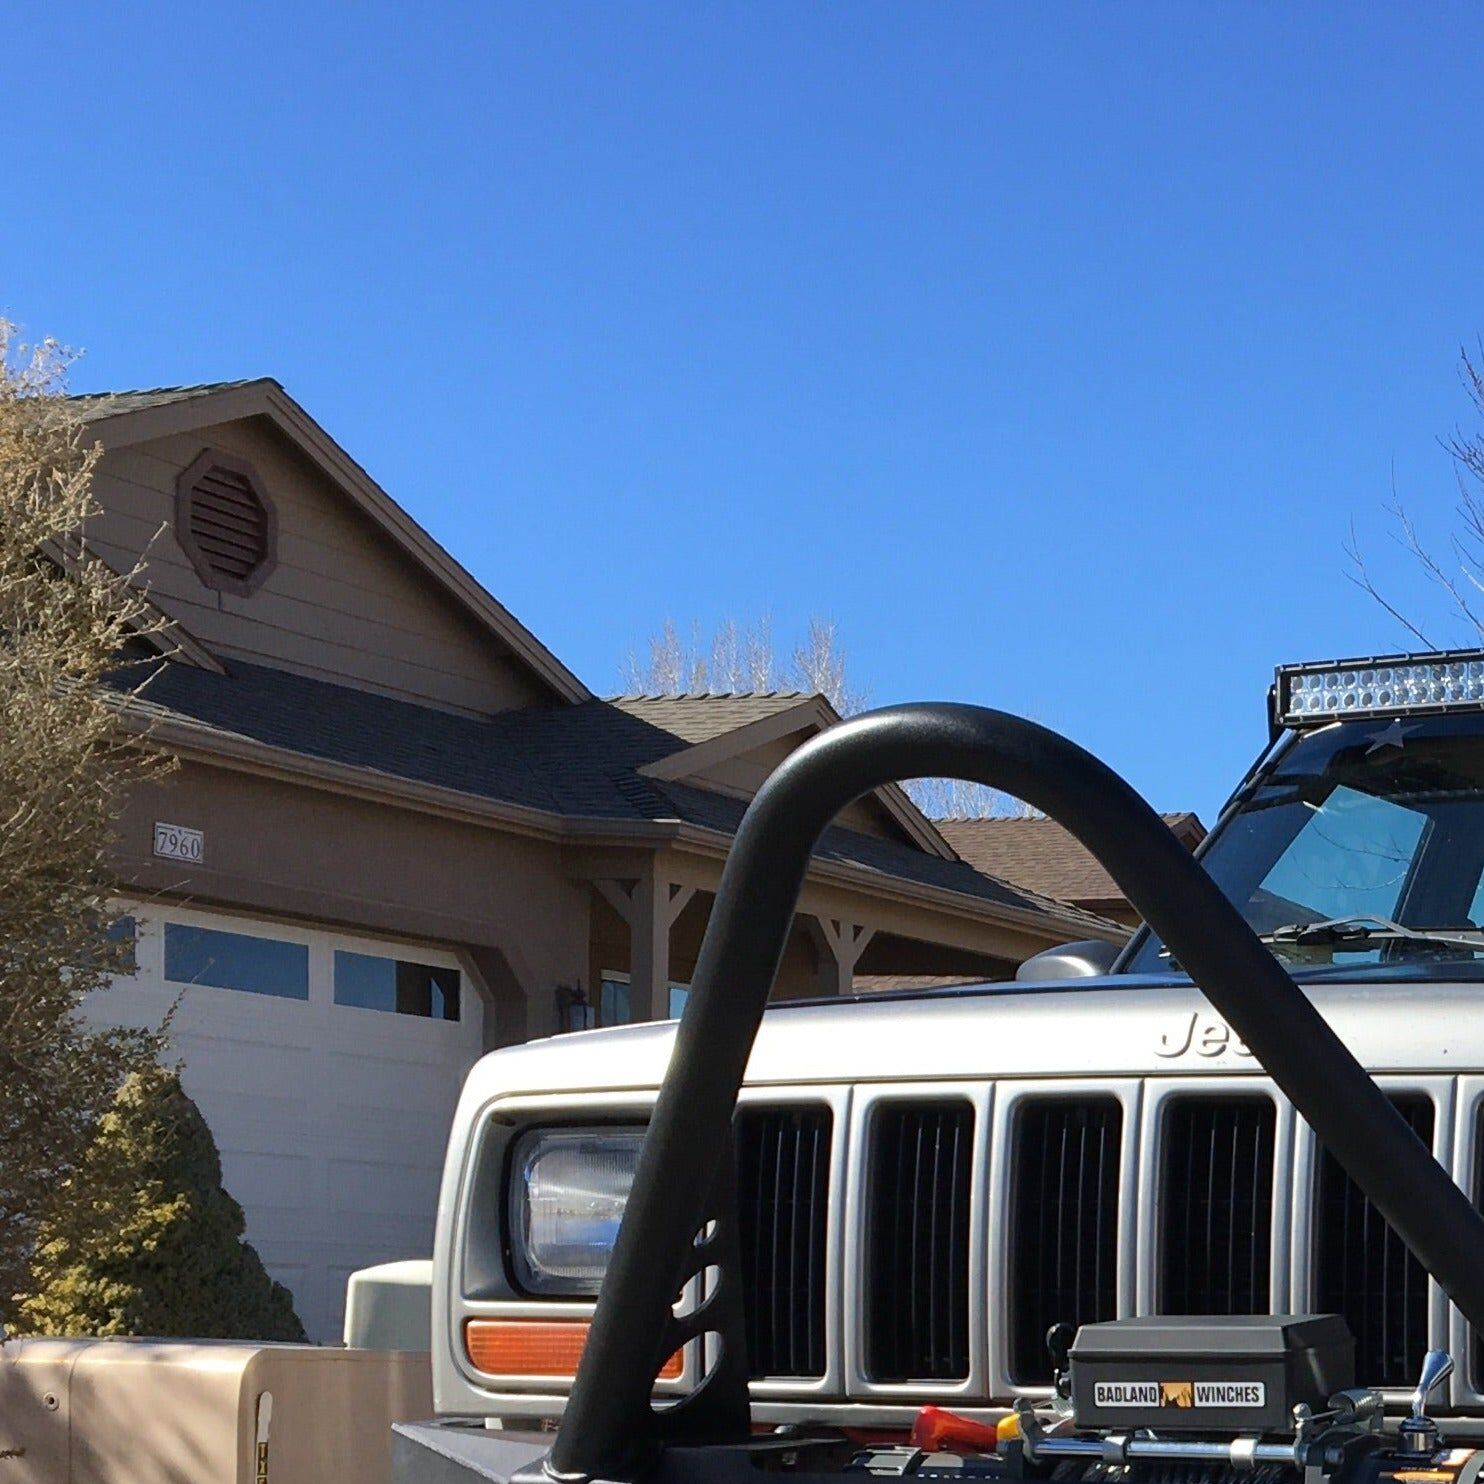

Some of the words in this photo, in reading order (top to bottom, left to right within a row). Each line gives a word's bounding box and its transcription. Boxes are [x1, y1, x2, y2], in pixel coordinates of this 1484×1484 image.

[158, 831, 200, 859] 7960
[1153, 1012, 1255, 1058] Je
[1097, 1386, 1157, 1403] BADLAND
[1196, 1386, 1260, 1403] WINCHES
